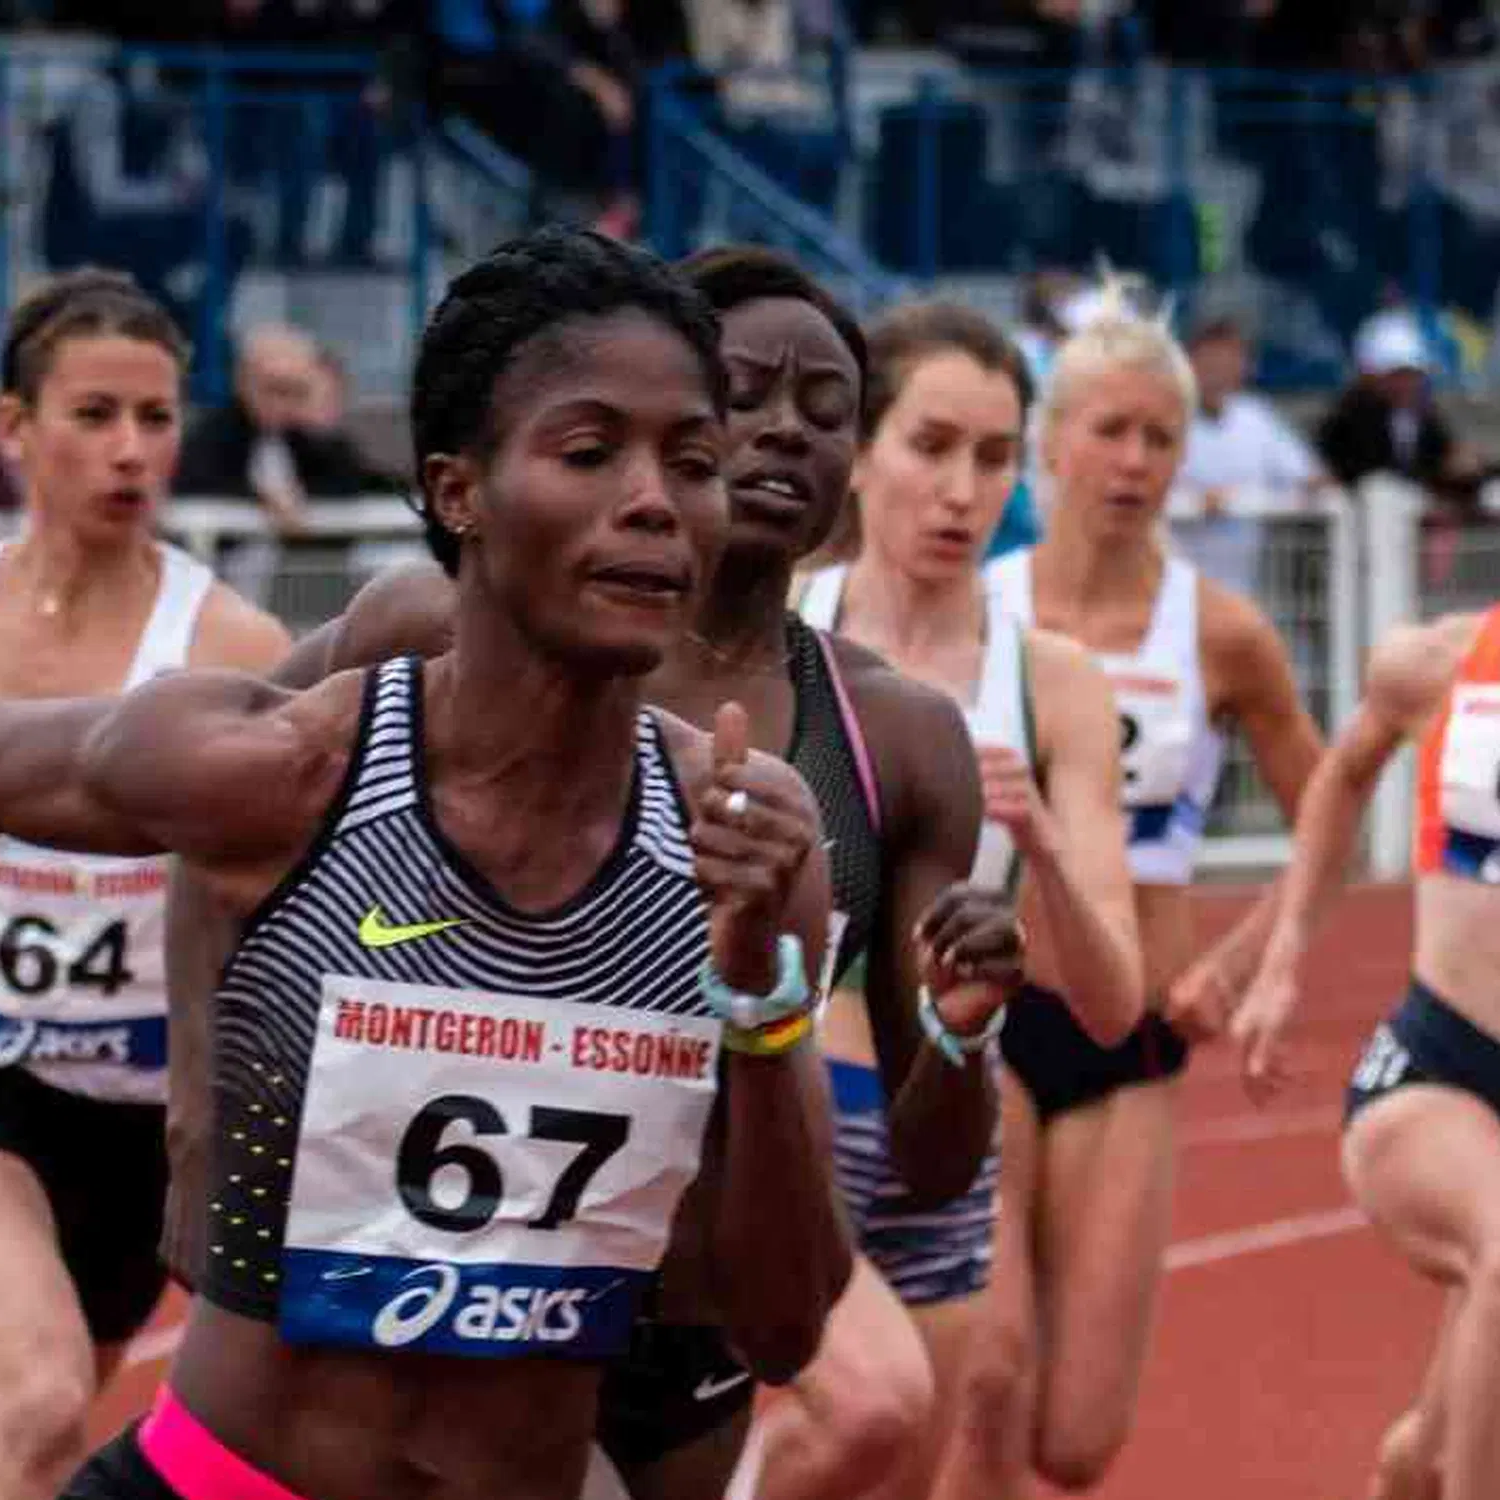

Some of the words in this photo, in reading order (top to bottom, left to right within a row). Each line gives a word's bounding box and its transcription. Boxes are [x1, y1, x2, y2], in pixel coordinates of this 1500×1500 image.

[333, 997, 545, 1062] MONTGERON
[572, 1026, 711, 1080] ESSONNE
[396, 1094, 631, 1232] 67
[454, 1284, 588, 1341] asics
